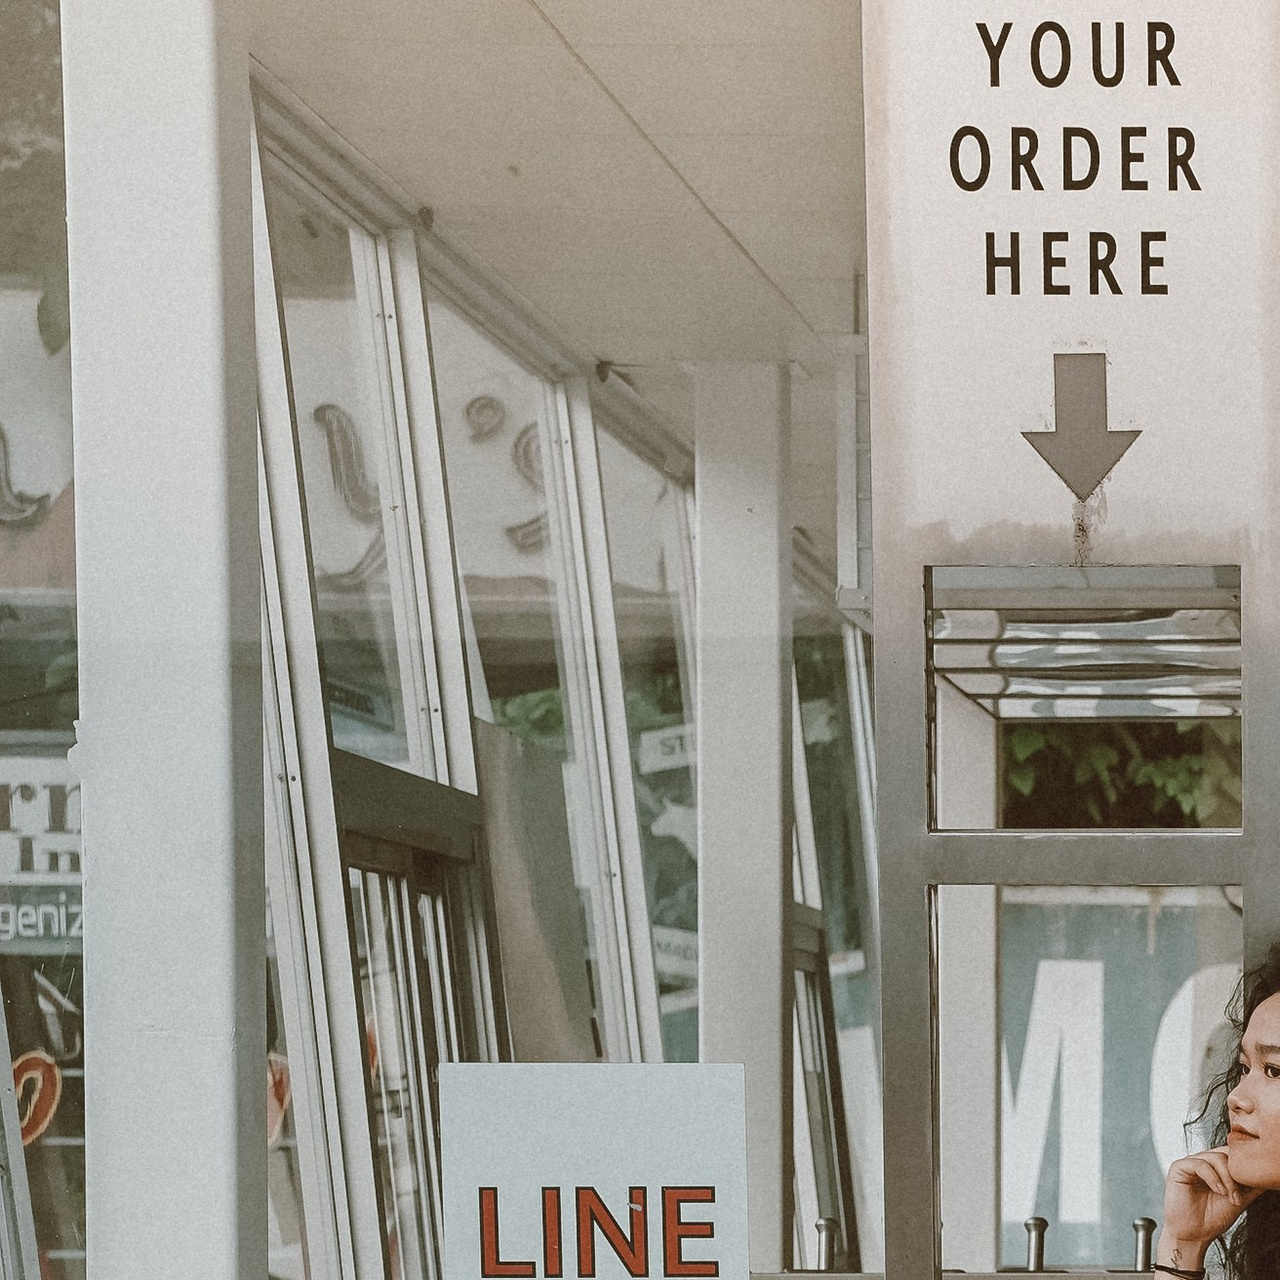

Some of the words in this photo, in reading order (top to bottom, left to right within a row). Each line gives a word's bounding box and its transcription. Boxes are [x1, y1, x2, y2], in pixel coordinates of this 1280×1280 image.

[975, 20, 1182, 89] YOUR
[948, 125, 1202, 192] ORDER
[985, 230, 1169, 296] HERE
[478, 1186, 720, 1279] LINE
